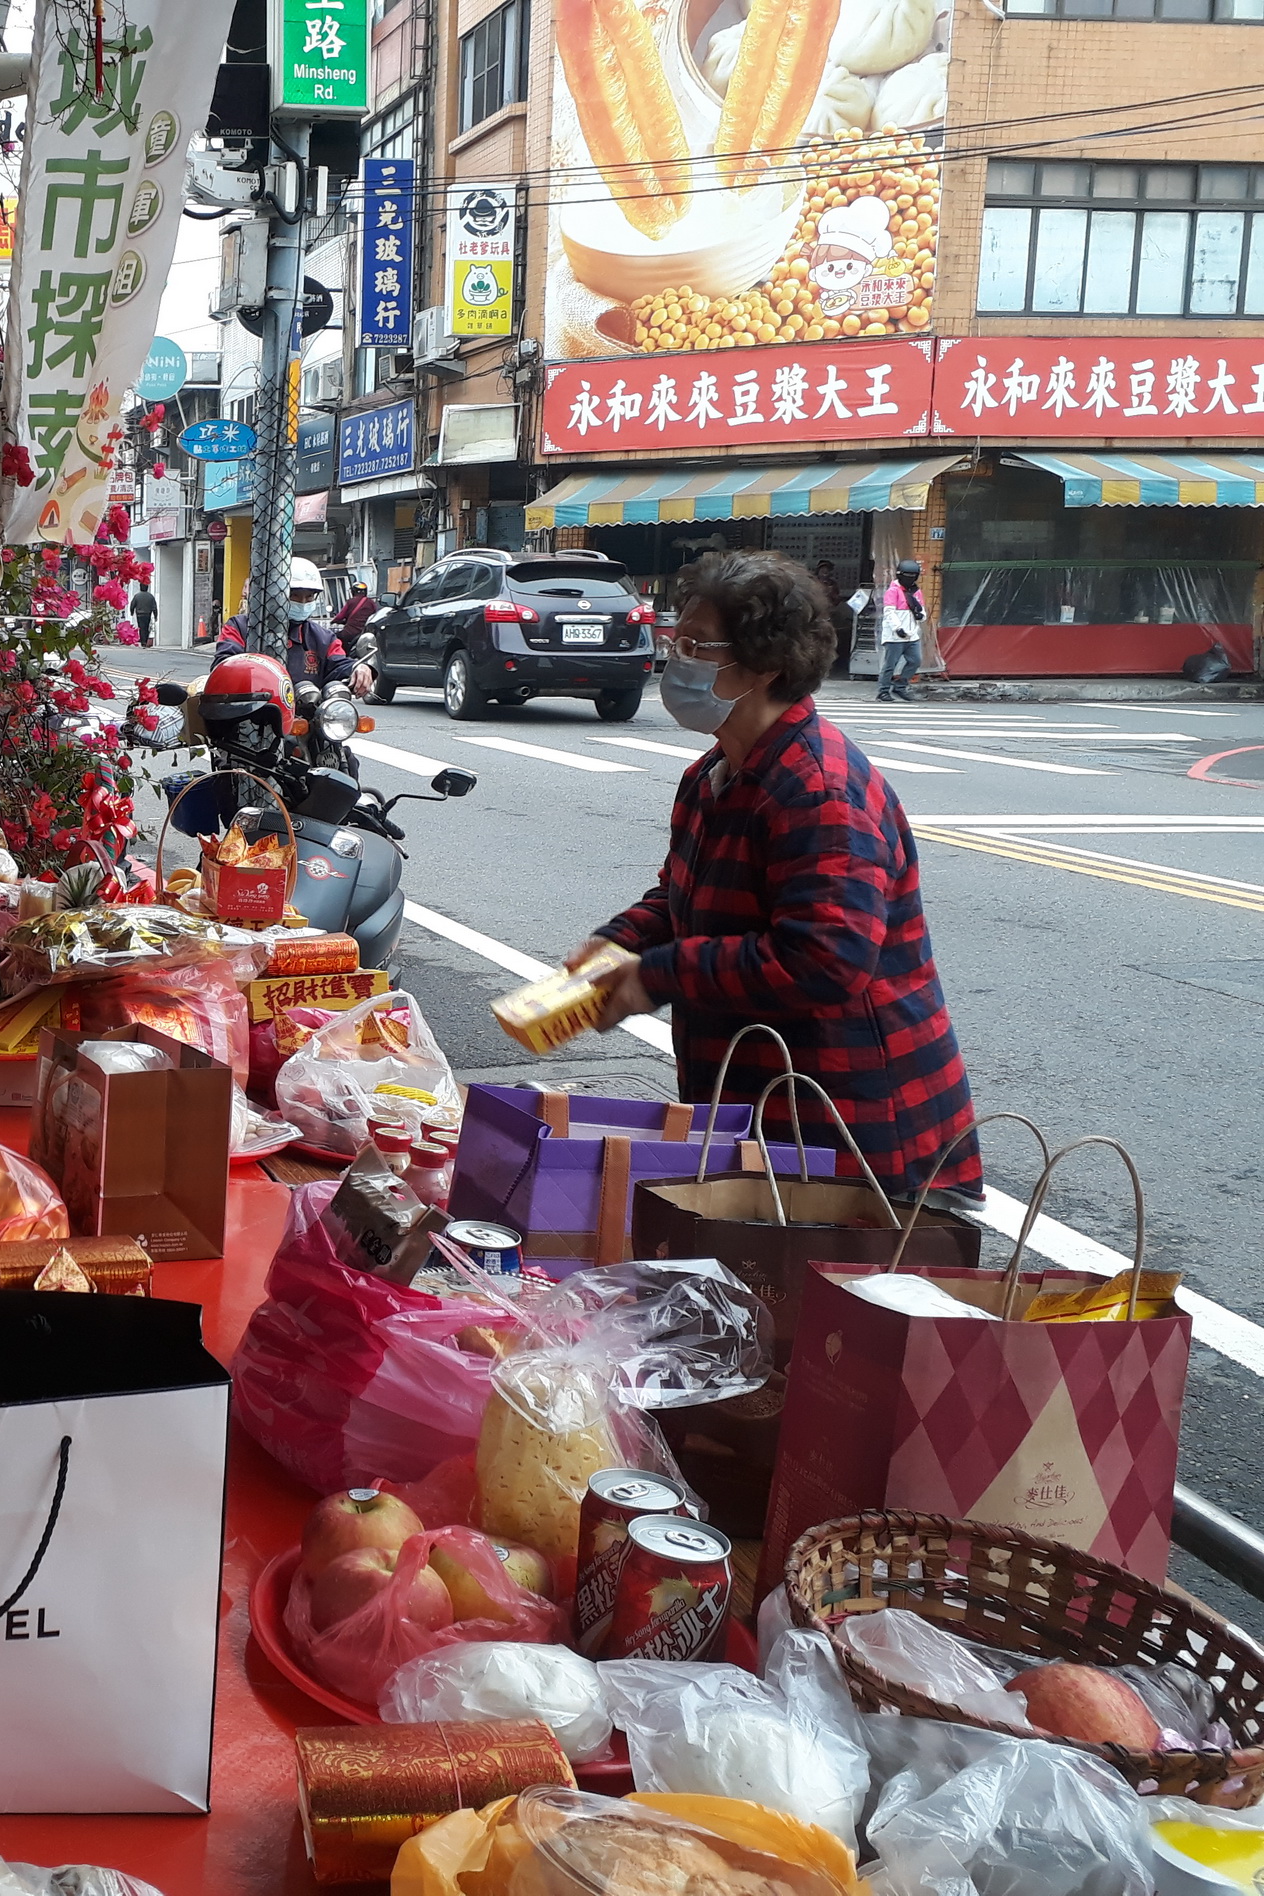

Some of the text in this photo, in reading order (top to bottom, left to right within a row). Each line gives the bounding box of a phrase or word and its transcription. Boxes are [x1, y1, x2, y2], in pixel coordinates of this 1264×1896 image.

[293, 63, 357, 85] Minsheng
[314, 84, 337, 100] Rd.
[236, 177, 261, 186] KOMOT
[112, 119, 172, 297] 童軍組
[27, 25, 154, 494] 城市探索
[373, 166, 405, 330] 三光玻璃行
[458, 241, 510, 256] 杜老爹玩具
[861, 277, 907, 293] 永和來來
[861, 291, 906, 307] 豆漿大王
[373, 332, 408, 345] 7223287
[565, 363, 900, 437] 永和來來豆漿大王
[960, 354, 1264, 419] 永和來來豆漿大王
[343, 407, 410, 459] 三光玻璃行
[263, 973, 376, 1010] 招財進寶
